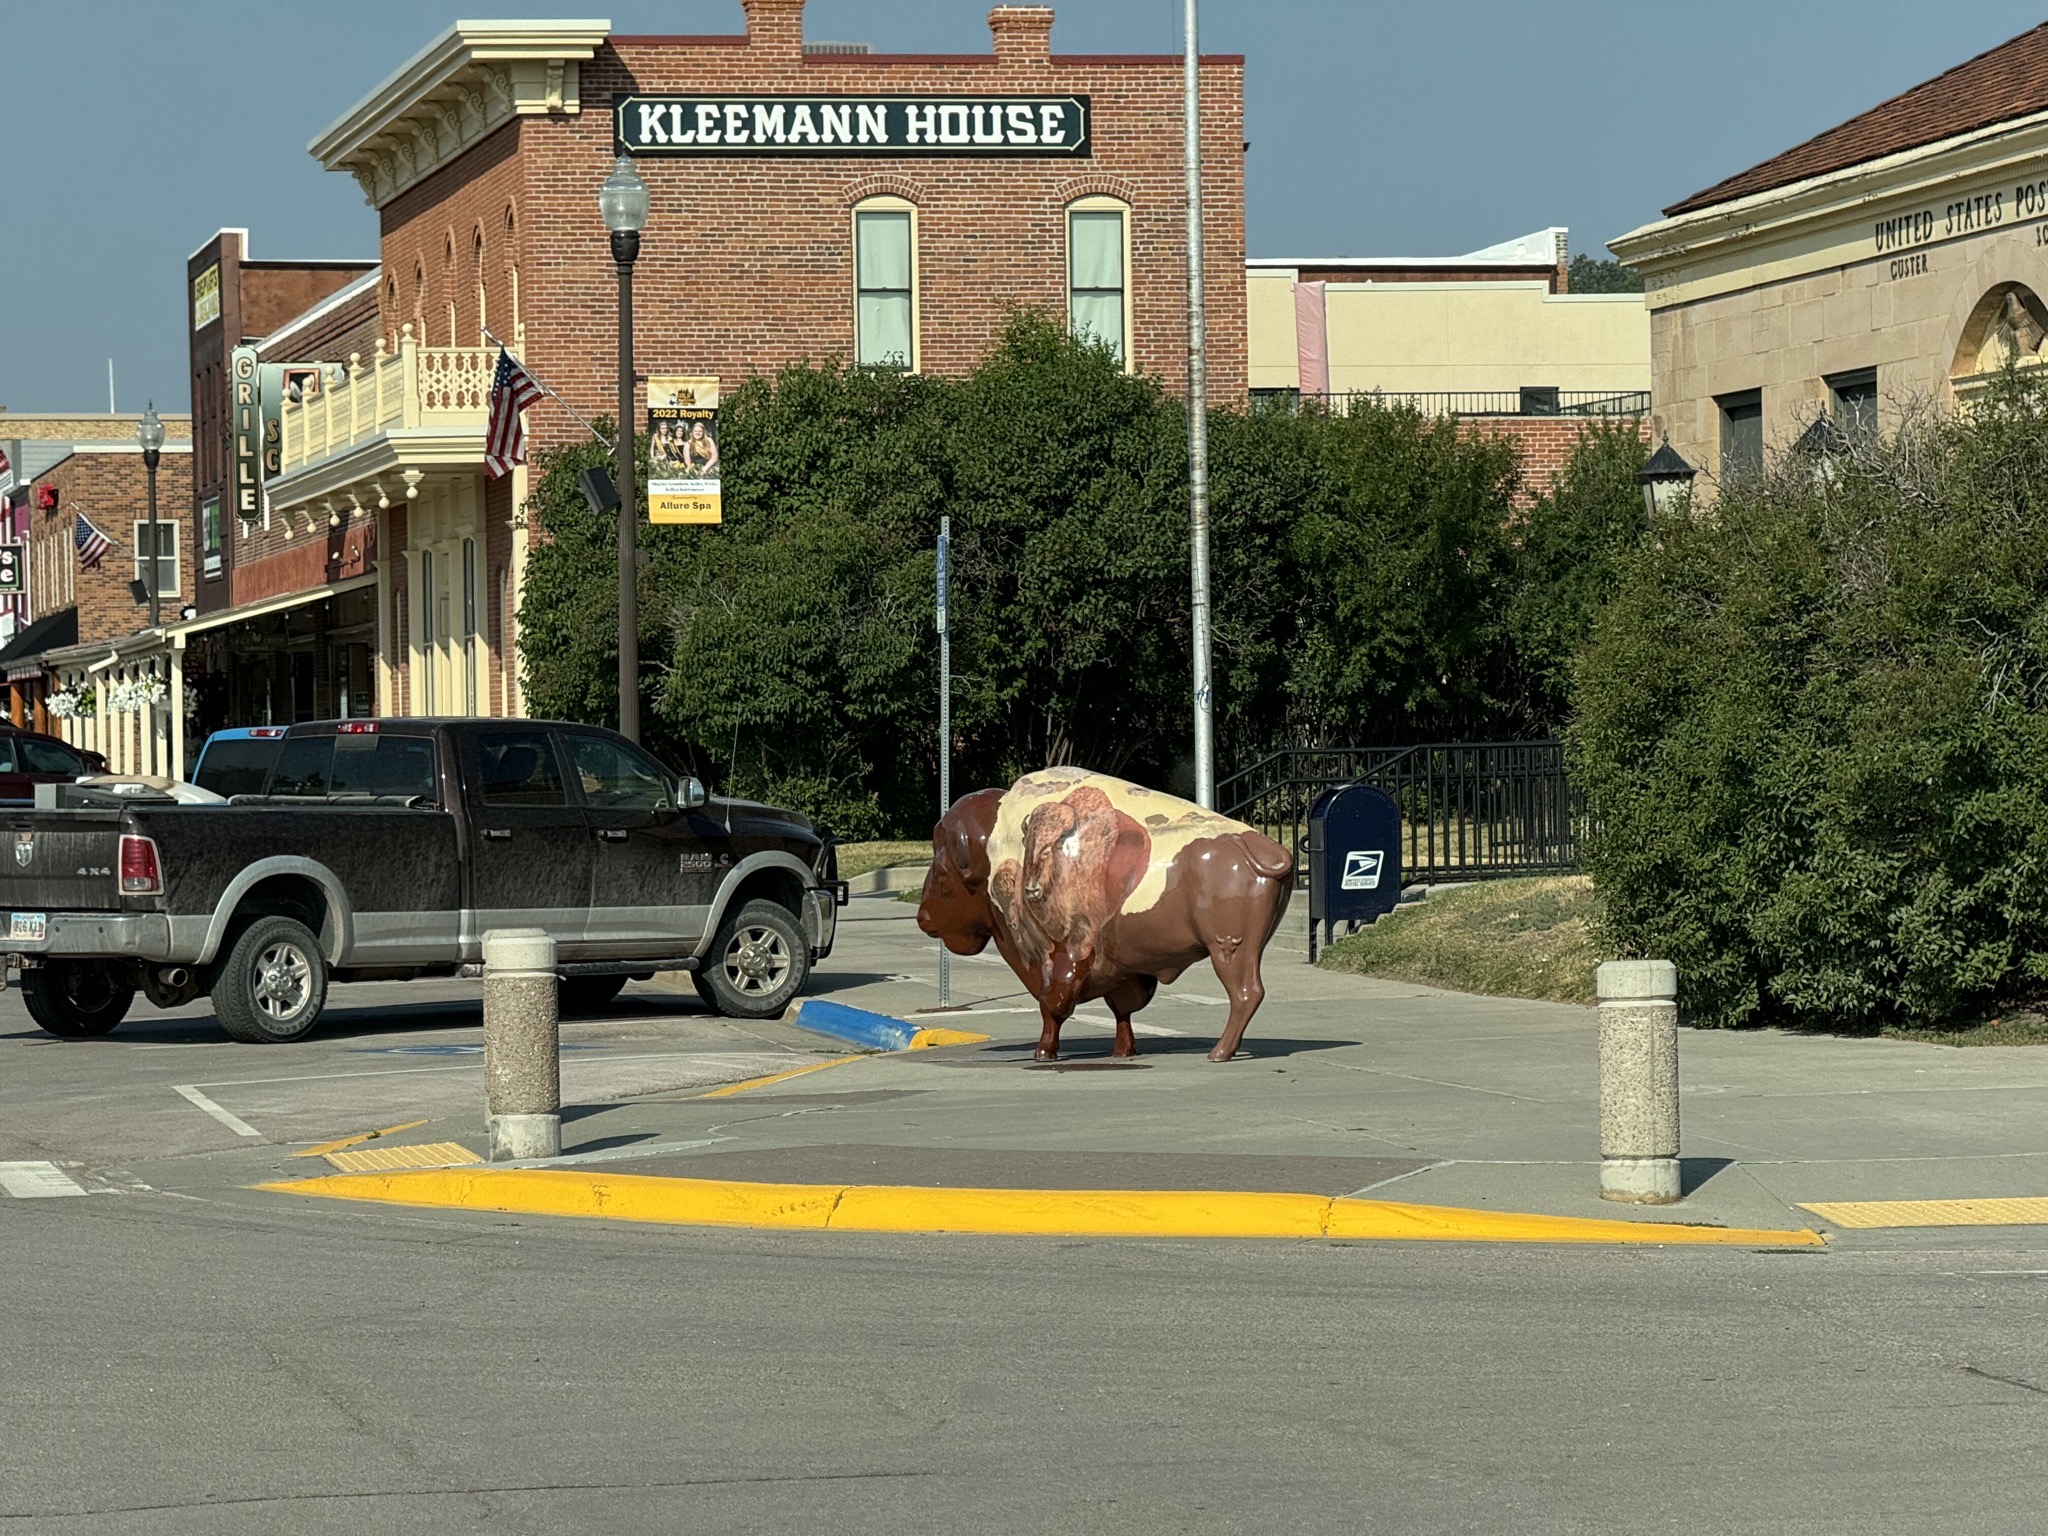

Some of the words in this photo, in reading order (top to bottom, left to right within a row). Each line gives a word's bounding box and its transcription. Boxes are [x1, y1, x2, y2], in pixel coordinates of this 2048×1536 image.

[637, 104, 889, 144] KLEEMANN
[905, 104, 1066, 144] HOUSE
[1875, 210, 1934, 253] UNITED
[1945, 192, 2003, 236] STATES
[2016, 179, 2048, 219] POS
[1890, 253, 1929, 281] CUSTER
[652, 409, 677, 418] 2022
[680, 409, 715, 420] Royalty
[235, 356, 257, 511] GRILLE
[660, 502, 690, 510] Allure
[692, 501, 712, 511] Spa
[680, 853, 713, 861] RAM
